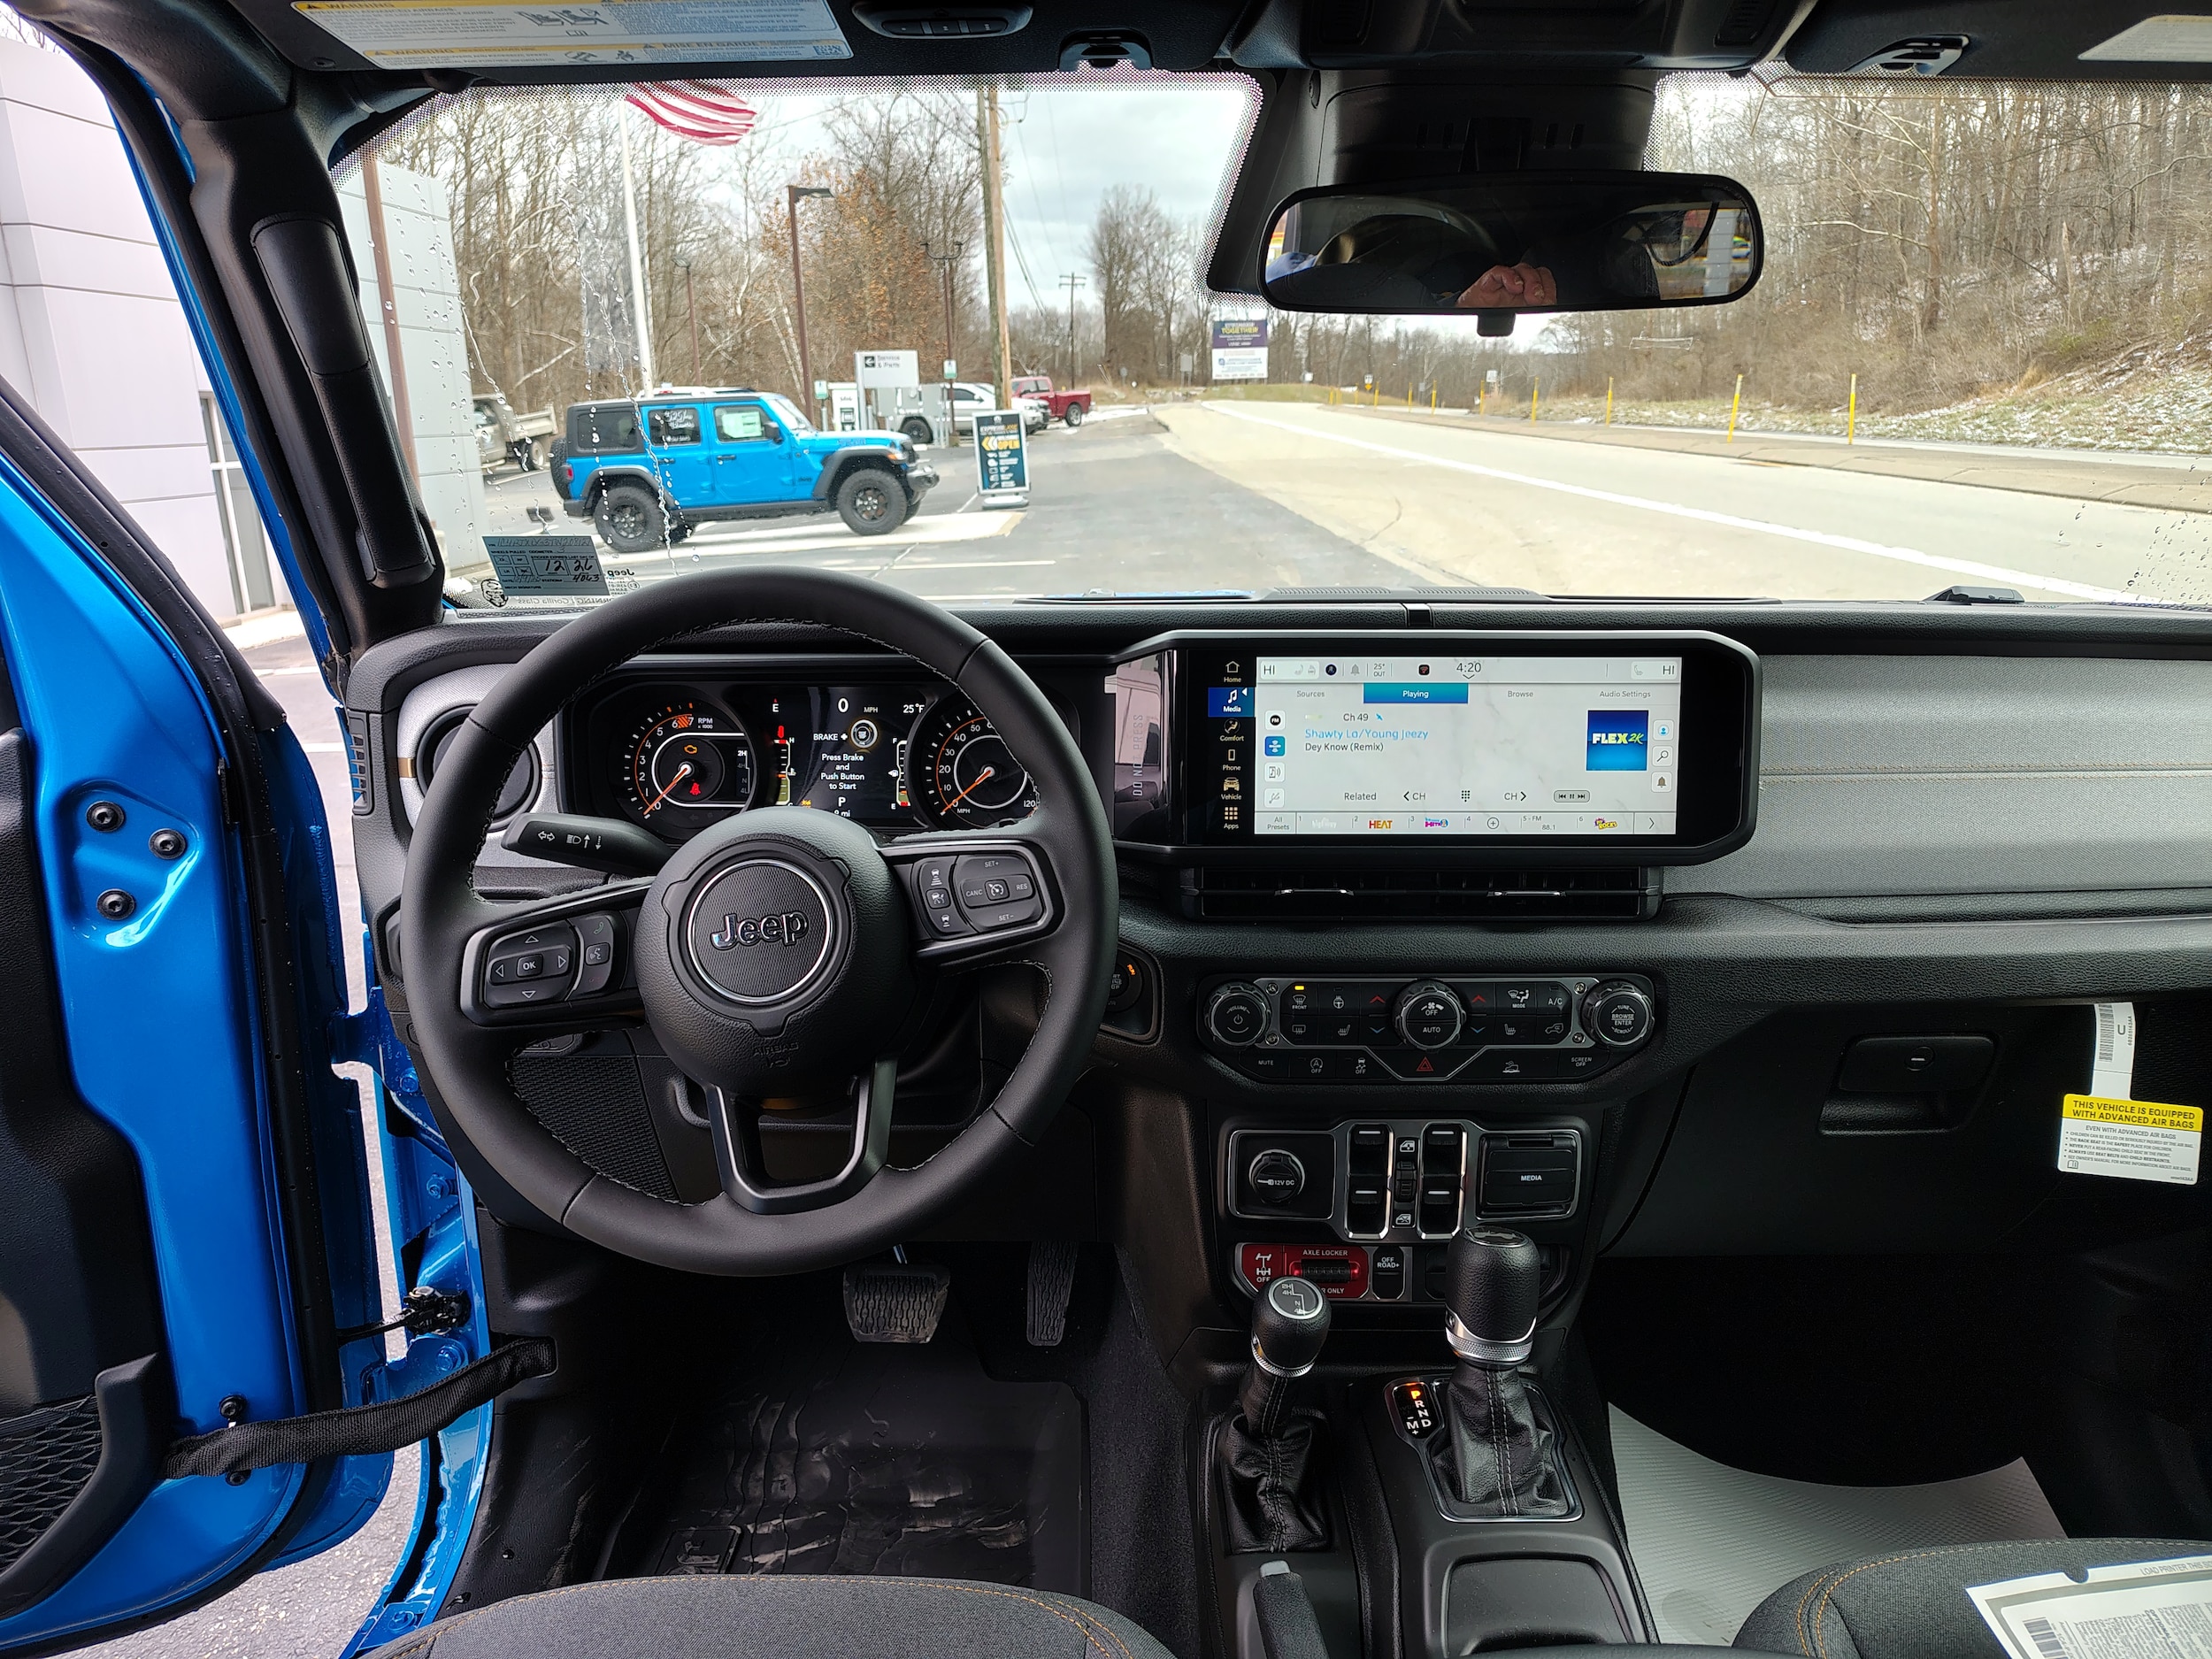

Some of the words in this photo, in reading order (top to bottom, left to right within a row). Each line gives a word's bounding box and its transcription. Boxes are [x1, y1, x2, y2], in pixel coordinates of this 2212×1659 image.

[546, 559, 565, 572] 12
[574, 557, 593, 572] 26
[572, 573, 600, 582] 4063
[1263, 665, 1275, 674] HI
[1456, 663, 1481, 672] 4:20
[1663, 665, 1674, 675] HI
[1622, 690, 1651, 699] Settings
[773, 703, 779, 712] E
[838, 698, 849, 712] 0
[688, 718, 694, 726] 7
[1343, 713, 1356, 722] Ch
[657, 727, 664, 736] 5
[1133, 715, 1142, 749] PRESS
[1305, 729, 1342, 740] Shawty
[1402, 729, 1428, 740] Jeezy
[1305, 743, 1322, 752] Dey
[1350, 742, 1384, 752] (Remix)
[640, 756, 646, 764] 3
[639, 772, 645, 781] 2
[1133, 782, 1142, 796] DO
[838, 797, 846, 807] P
[1369, 820, 1393, 829] HEAT
[710, 911, 809, 950] Jeep
[2117, 1025, 2125, 1035] U
[753, 1042, 800, 1056] AIRBAG
[2097, 1102, 2135, 1113] VEHICLE
[2149, 1107, 2194, 1119] EQUIPPED
[2073, 1110, 2096, 1118] WITH
[2099, 1112, 2148, 1124] ADVANCED
[2152, 1117, 2166, 1125] AIR
[2170, 1119, 2194, 1129] BAGS
[1411, 1390, 1421, 1400] P
[2139, 1566, 2159, 1575] LOAD
[2159, 1563, 2188, 1573] PRINTER
